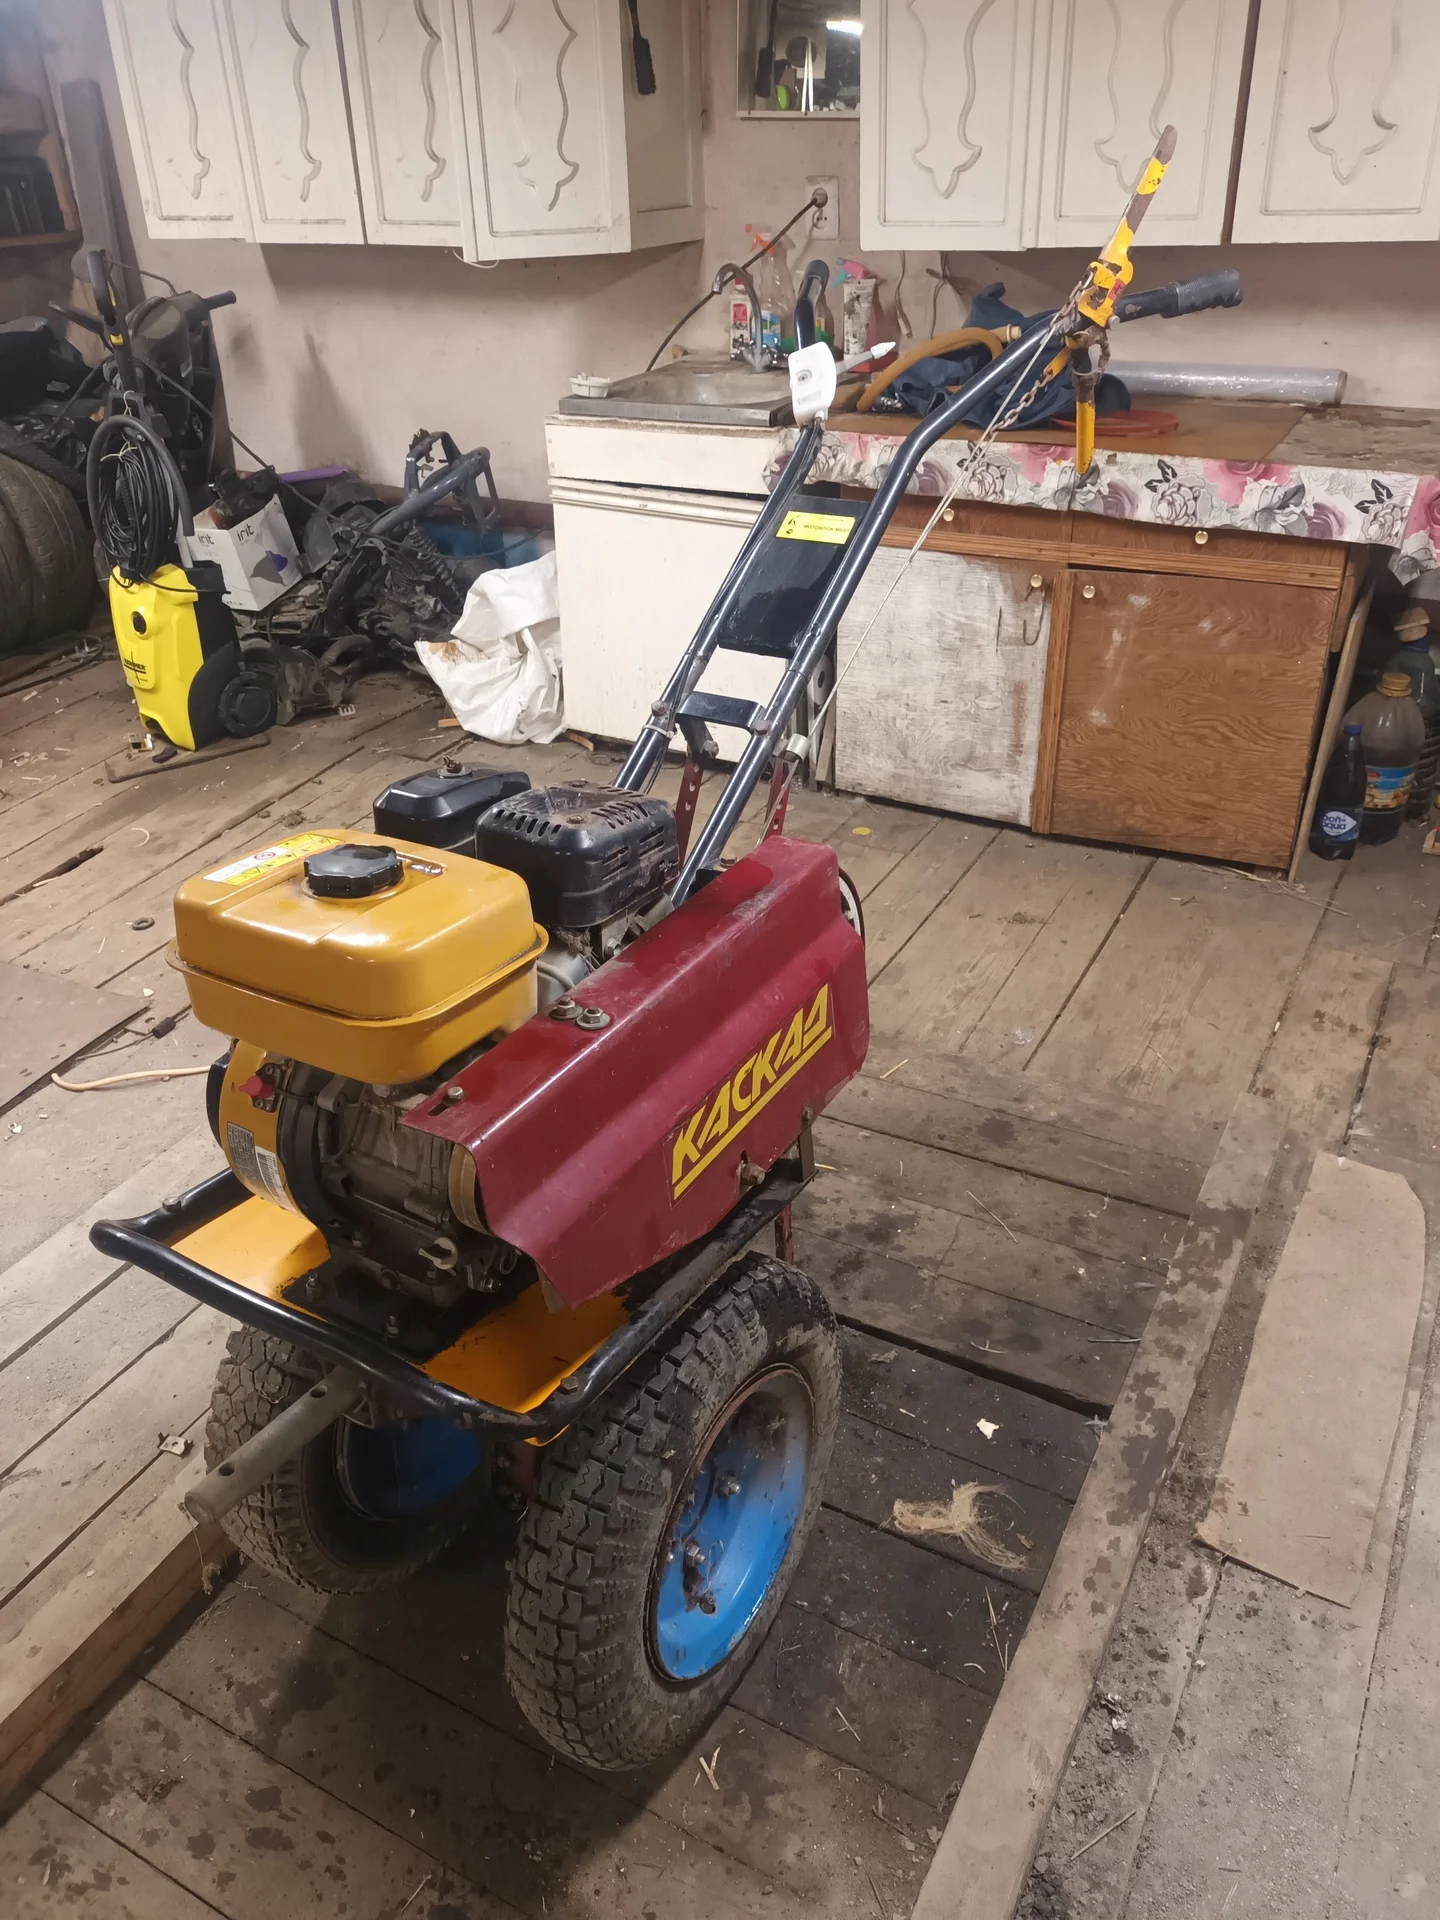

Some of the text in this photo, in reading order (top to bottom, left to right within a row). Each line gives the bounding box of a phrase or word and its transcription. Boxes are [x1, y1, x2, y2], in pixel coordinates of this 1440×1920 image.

[196, 533, 214, 545] irit
[236, 523, 254, 542] irit
[1321, 821, 1346, 831] aqua
[672, 983, 829, 1185] КАСКАД
